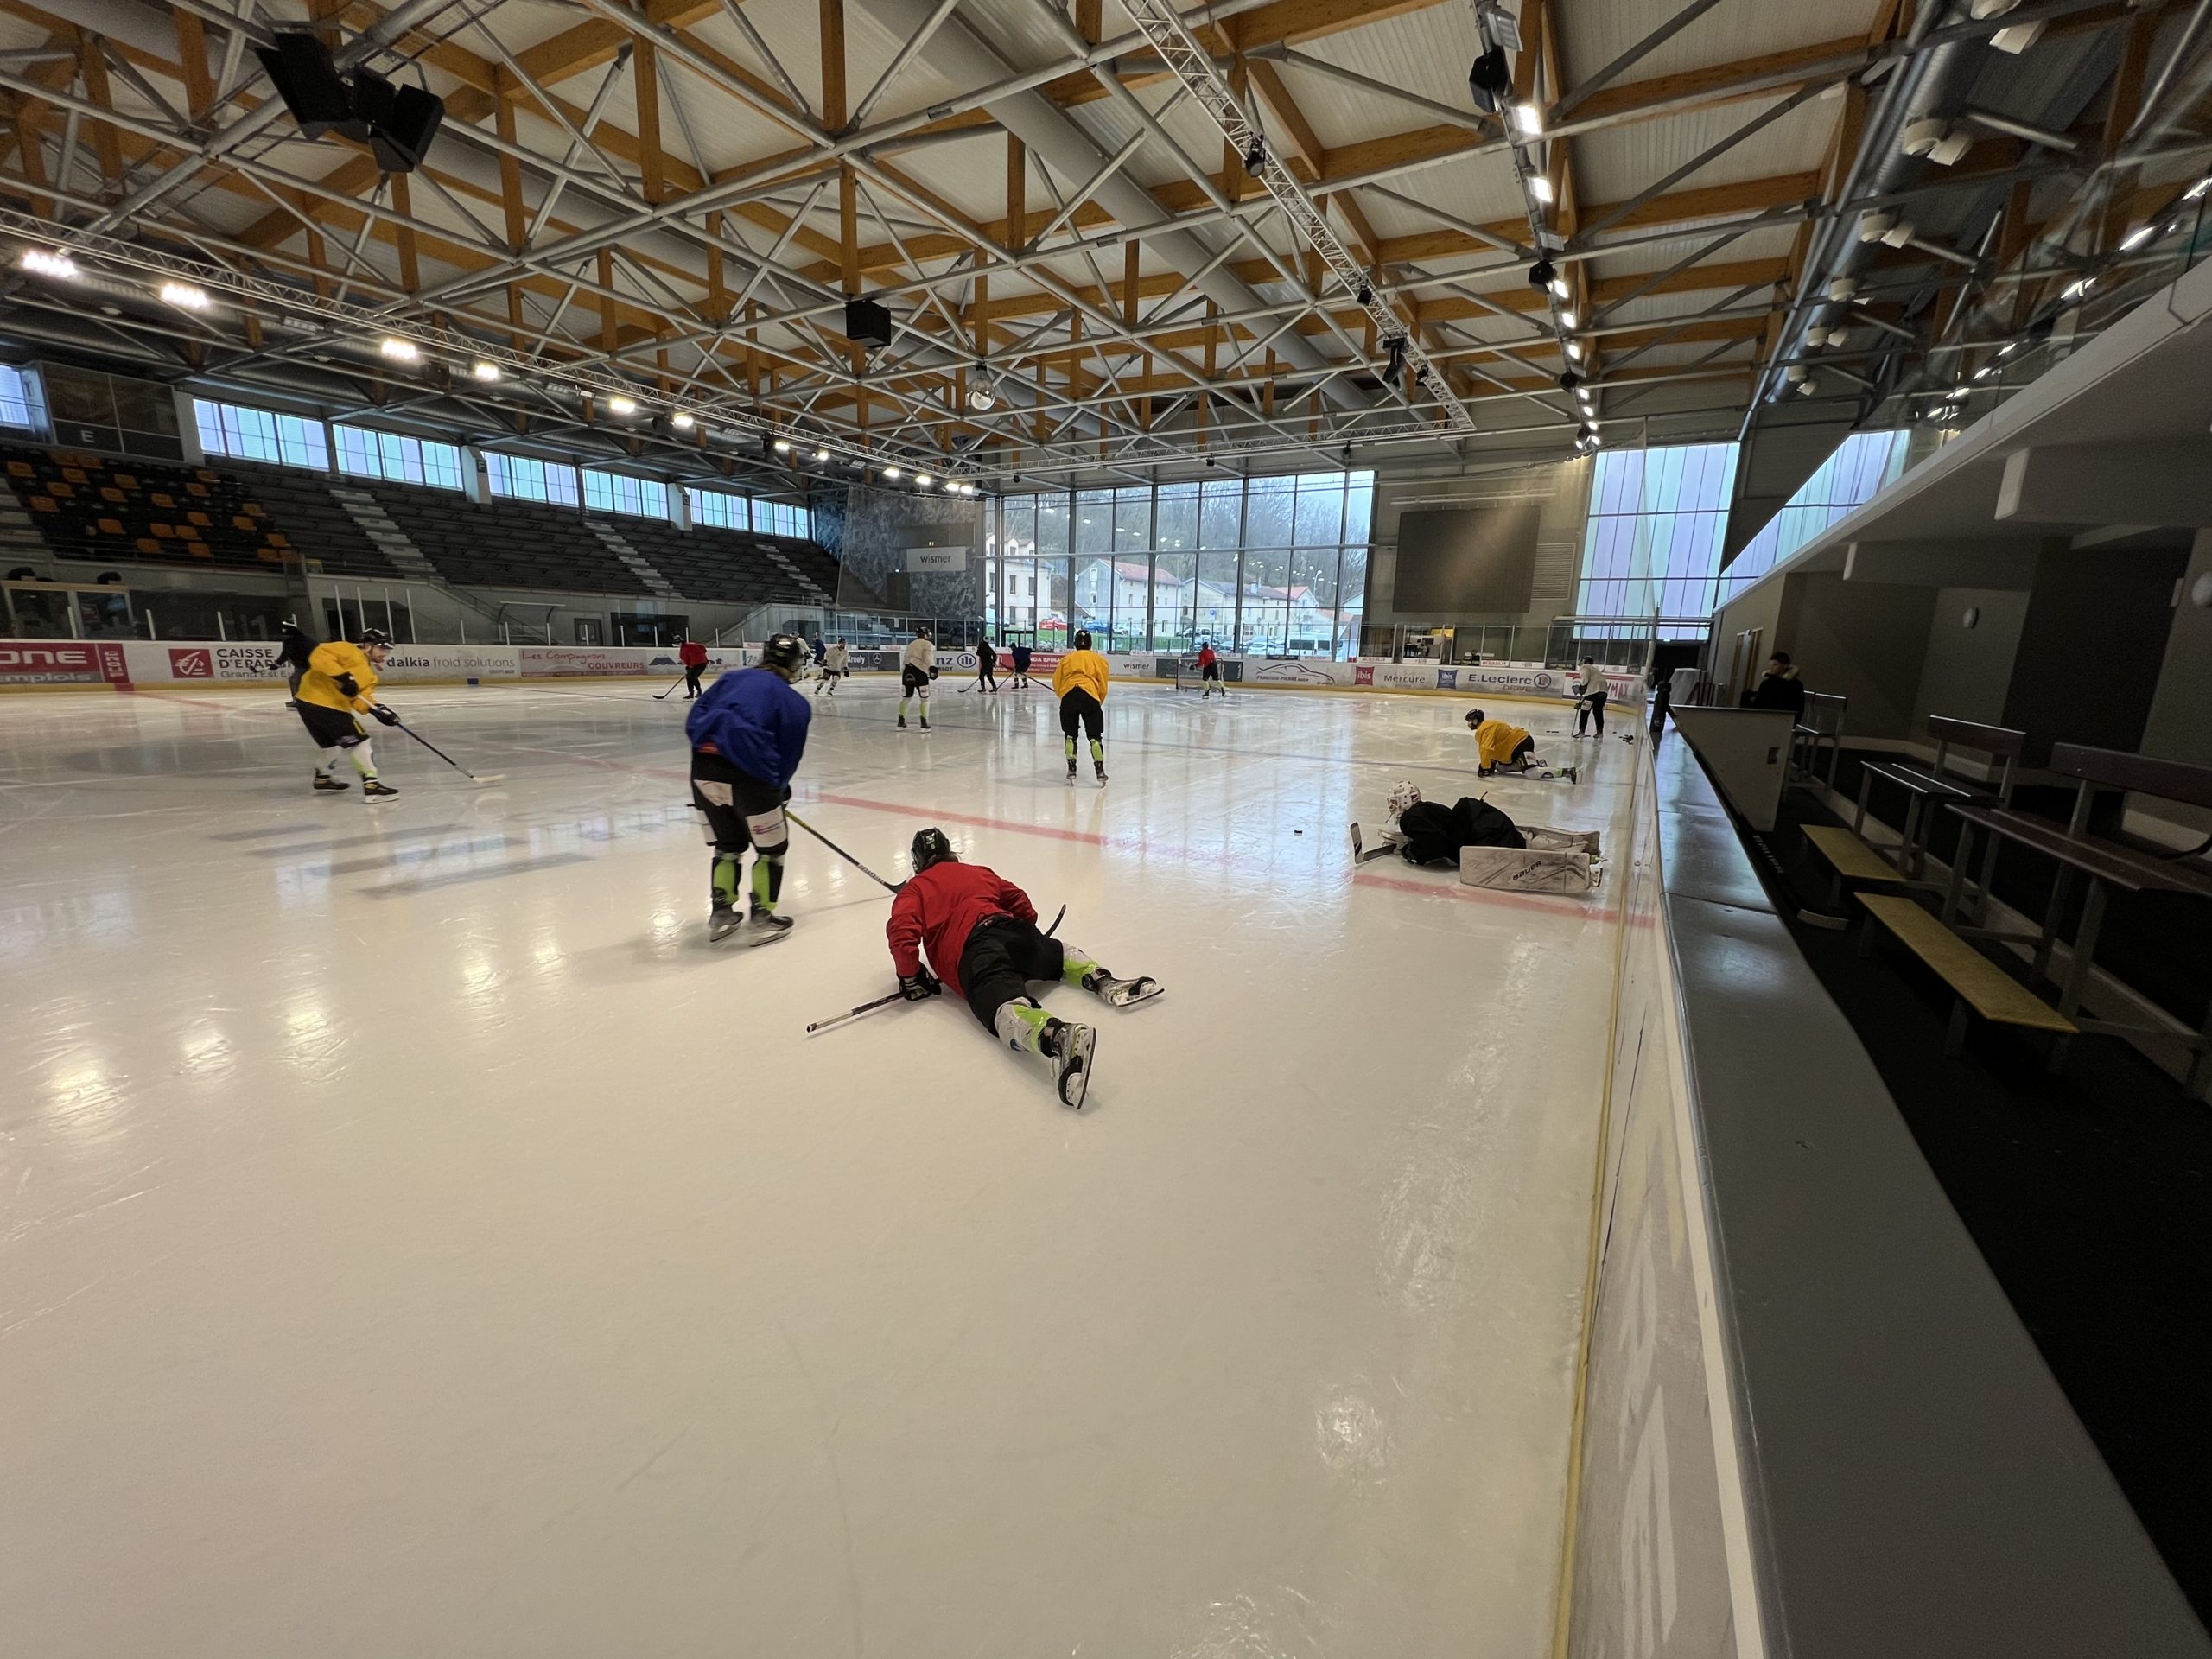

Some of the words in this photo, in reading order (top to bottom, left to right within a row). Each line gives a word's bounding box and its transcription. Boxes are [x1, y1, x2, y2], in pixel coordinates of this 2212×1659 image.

[80, 430, 96, 443] E
[920, 555, 951, 563] wismer
[217, 648, 274, 658] CAISSE
[522, 650, 542, 660] Les
[546, 650, 607, 664] Compagnons
[387, 657, 429, 667] dalkia
[434, 657, 460, 667] froid
[464, 657, 515, 668] solutions
[588, 662, 645, 671] COUVREURS
[1357, 671, 1371, 679] ibis
[1384, 675, 1426, 683] Mercure
[1469, 674, 1532, 685] E.Leclerc
[1513, 861, 1541, 880] BAUER
